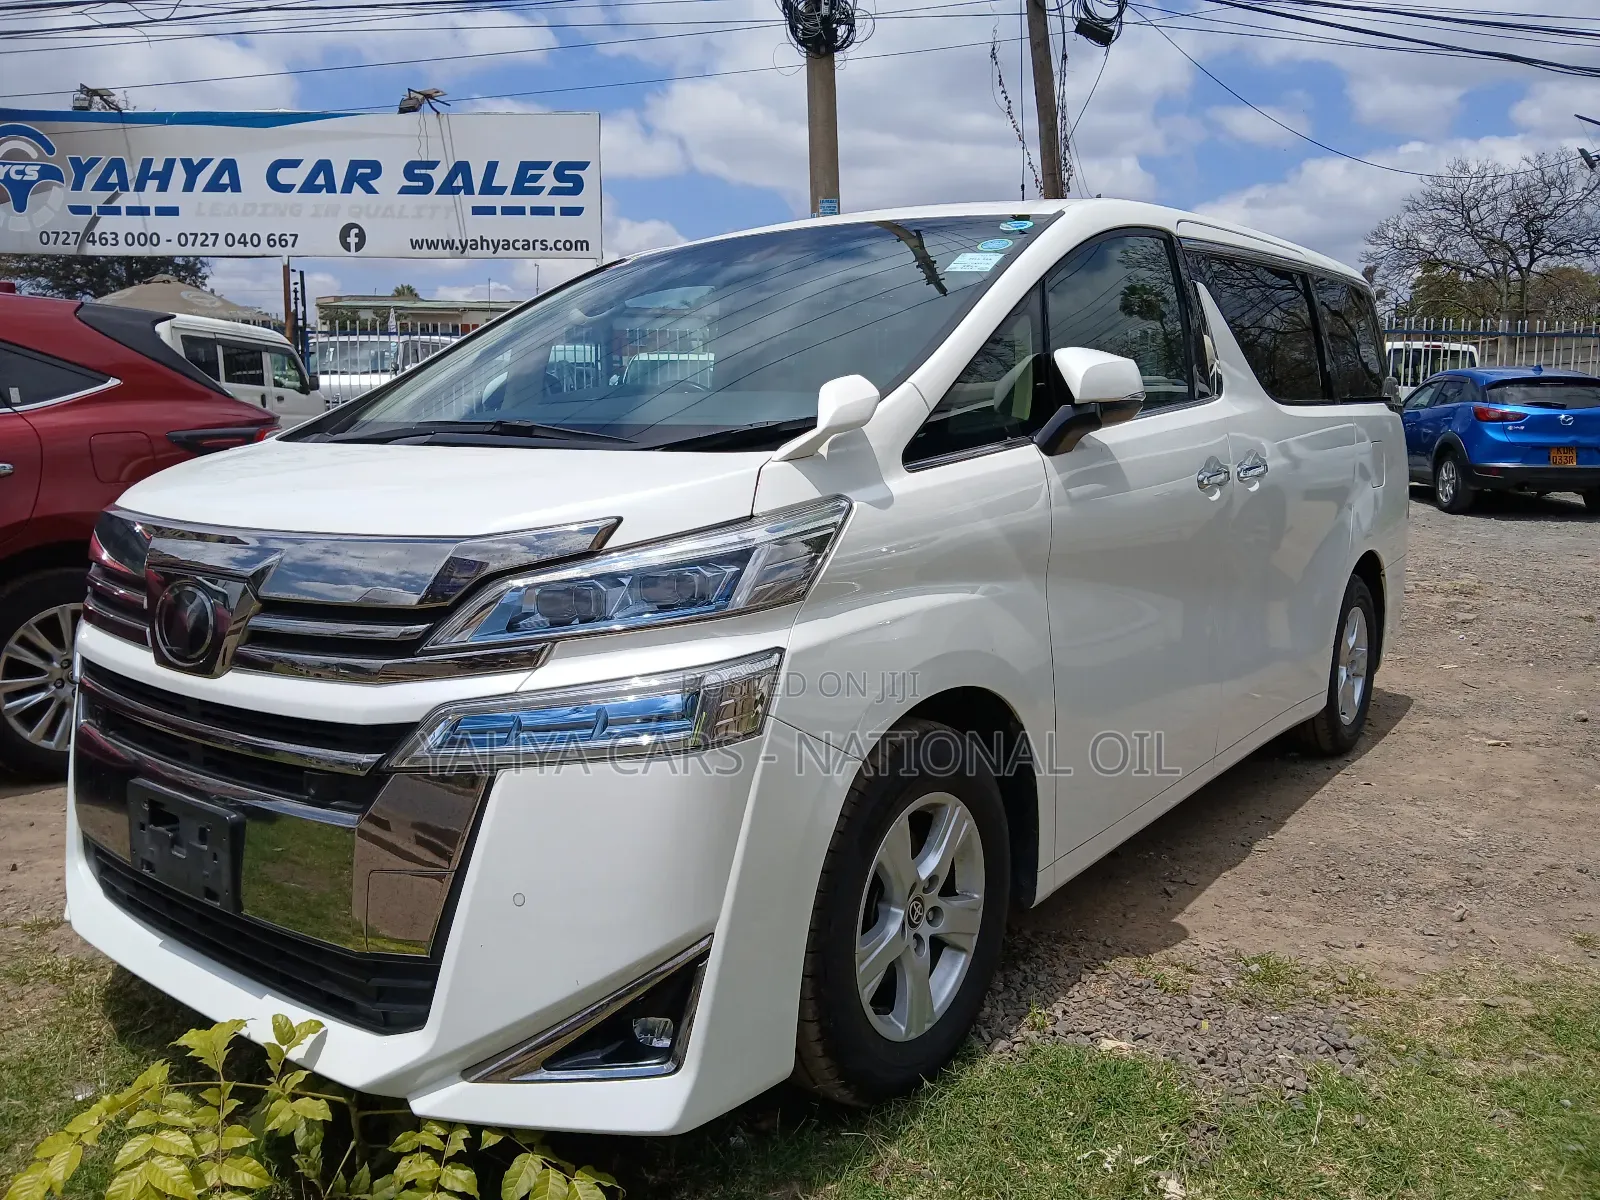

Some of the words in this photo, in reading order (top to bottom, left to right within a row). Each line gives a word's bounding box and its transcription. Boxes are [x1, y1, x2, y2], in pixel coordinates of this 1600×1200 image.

[66, 155, 242, 193] YAHYA
[265, 158, 382, 195] CAR
[397, 160, 591, 197] SALES
[194, 201, 302, 219] LEADING
[347, 203, 457, 221] QUALITY
[39, 230, 81, 246] 0727
[86, 231, 119, 247] 463
[124, 232, 161, 248] 000
[177, 232, 219, 248] 0727
[224, 232, 261, 248] 040
[266, 233, 299, 248] 667
[409, 235, 590, 255] www.yahyacars.com
